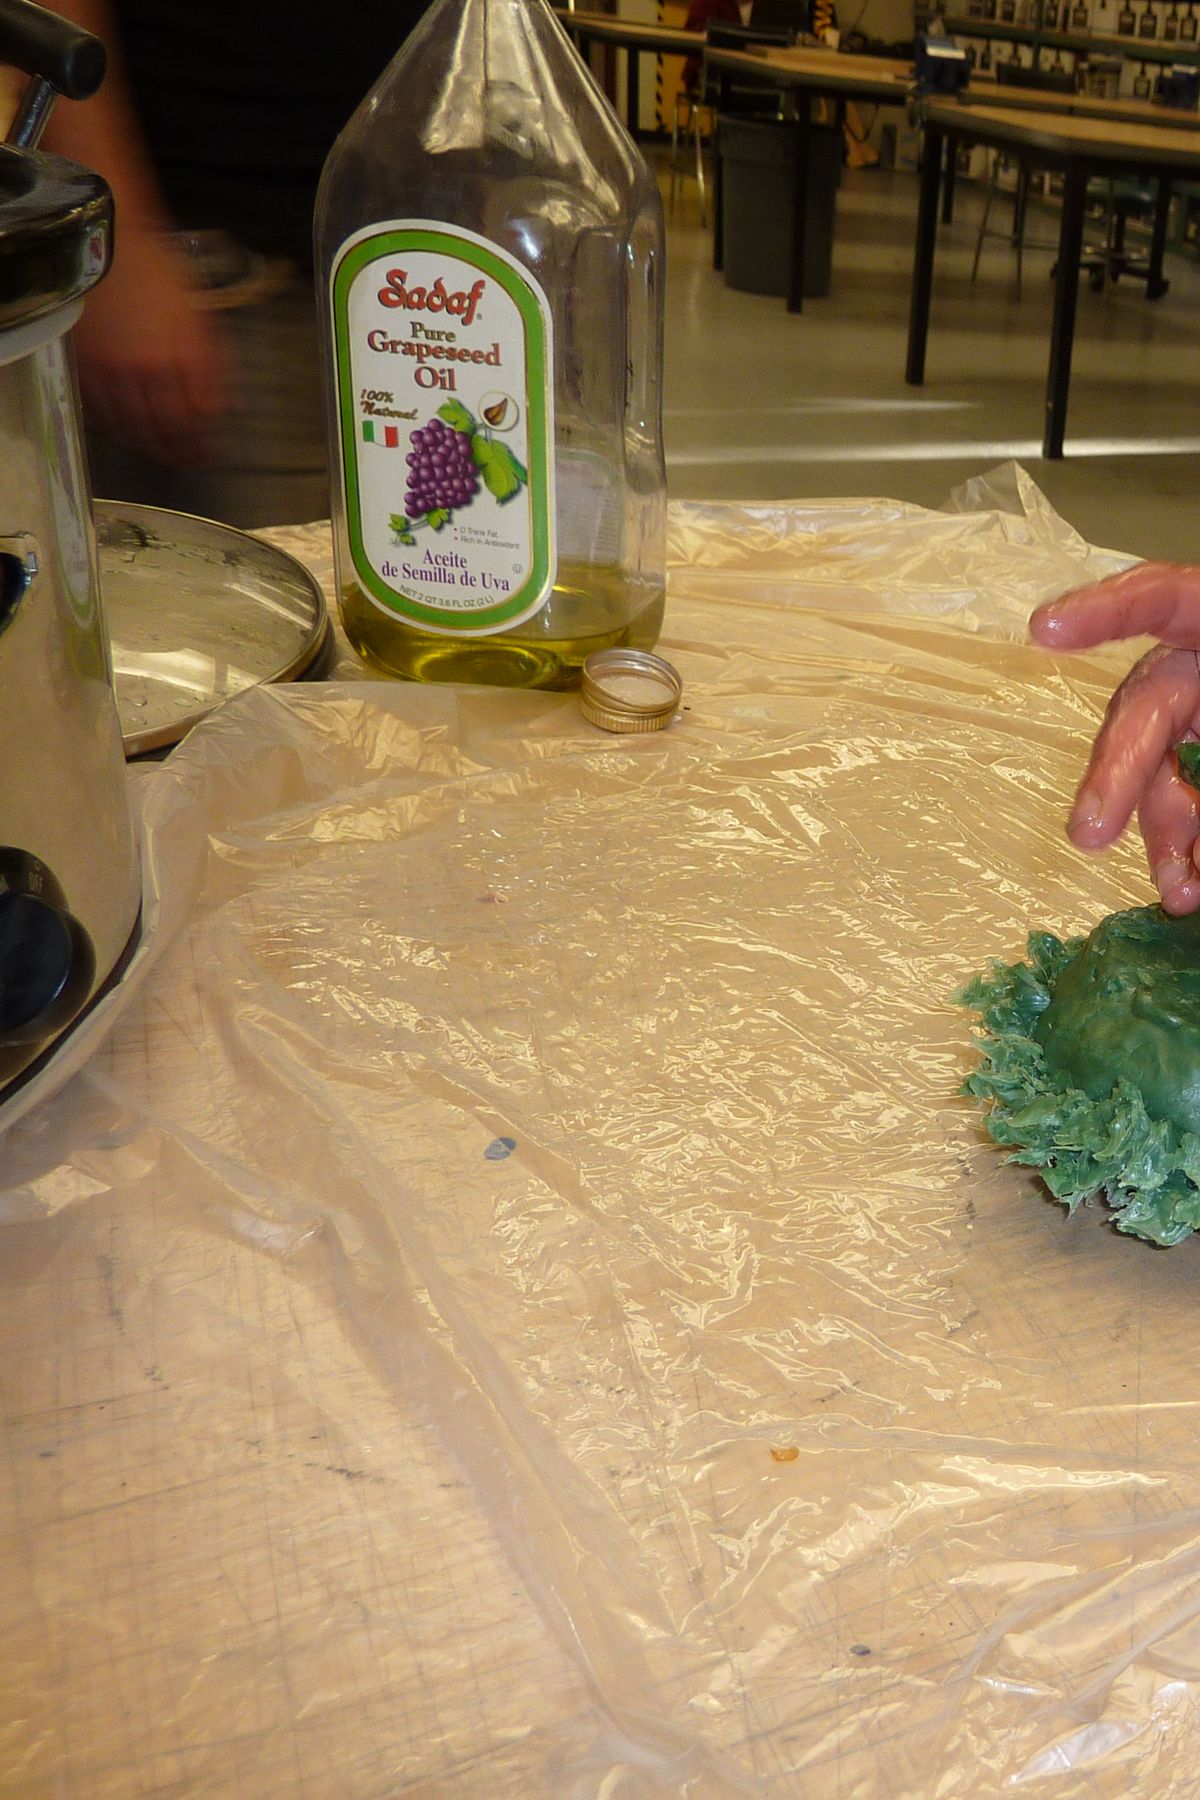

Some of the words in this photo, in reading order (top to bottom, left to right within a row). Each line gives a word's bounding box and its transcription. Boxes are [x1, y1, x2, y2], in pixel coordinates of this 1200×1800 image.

[378, 268, 486, 326] Sadaf
[410, 321, 456, 342] Pure
[367, 329, 502, 366] Grapeseed
[414, 366, 457, 391] Oil
[361, 389, 394, 403] 100%
[360, 400, 418, 420] Natural
[423, 549, 467, 569] Aceite
[382, 561, 398, 578] de
[402, 563, 455, 585] Semilla
[460, 571, 477, 587] de
[481, 575, 510, 592] Uva
[400, 584, 418, 598] NET
